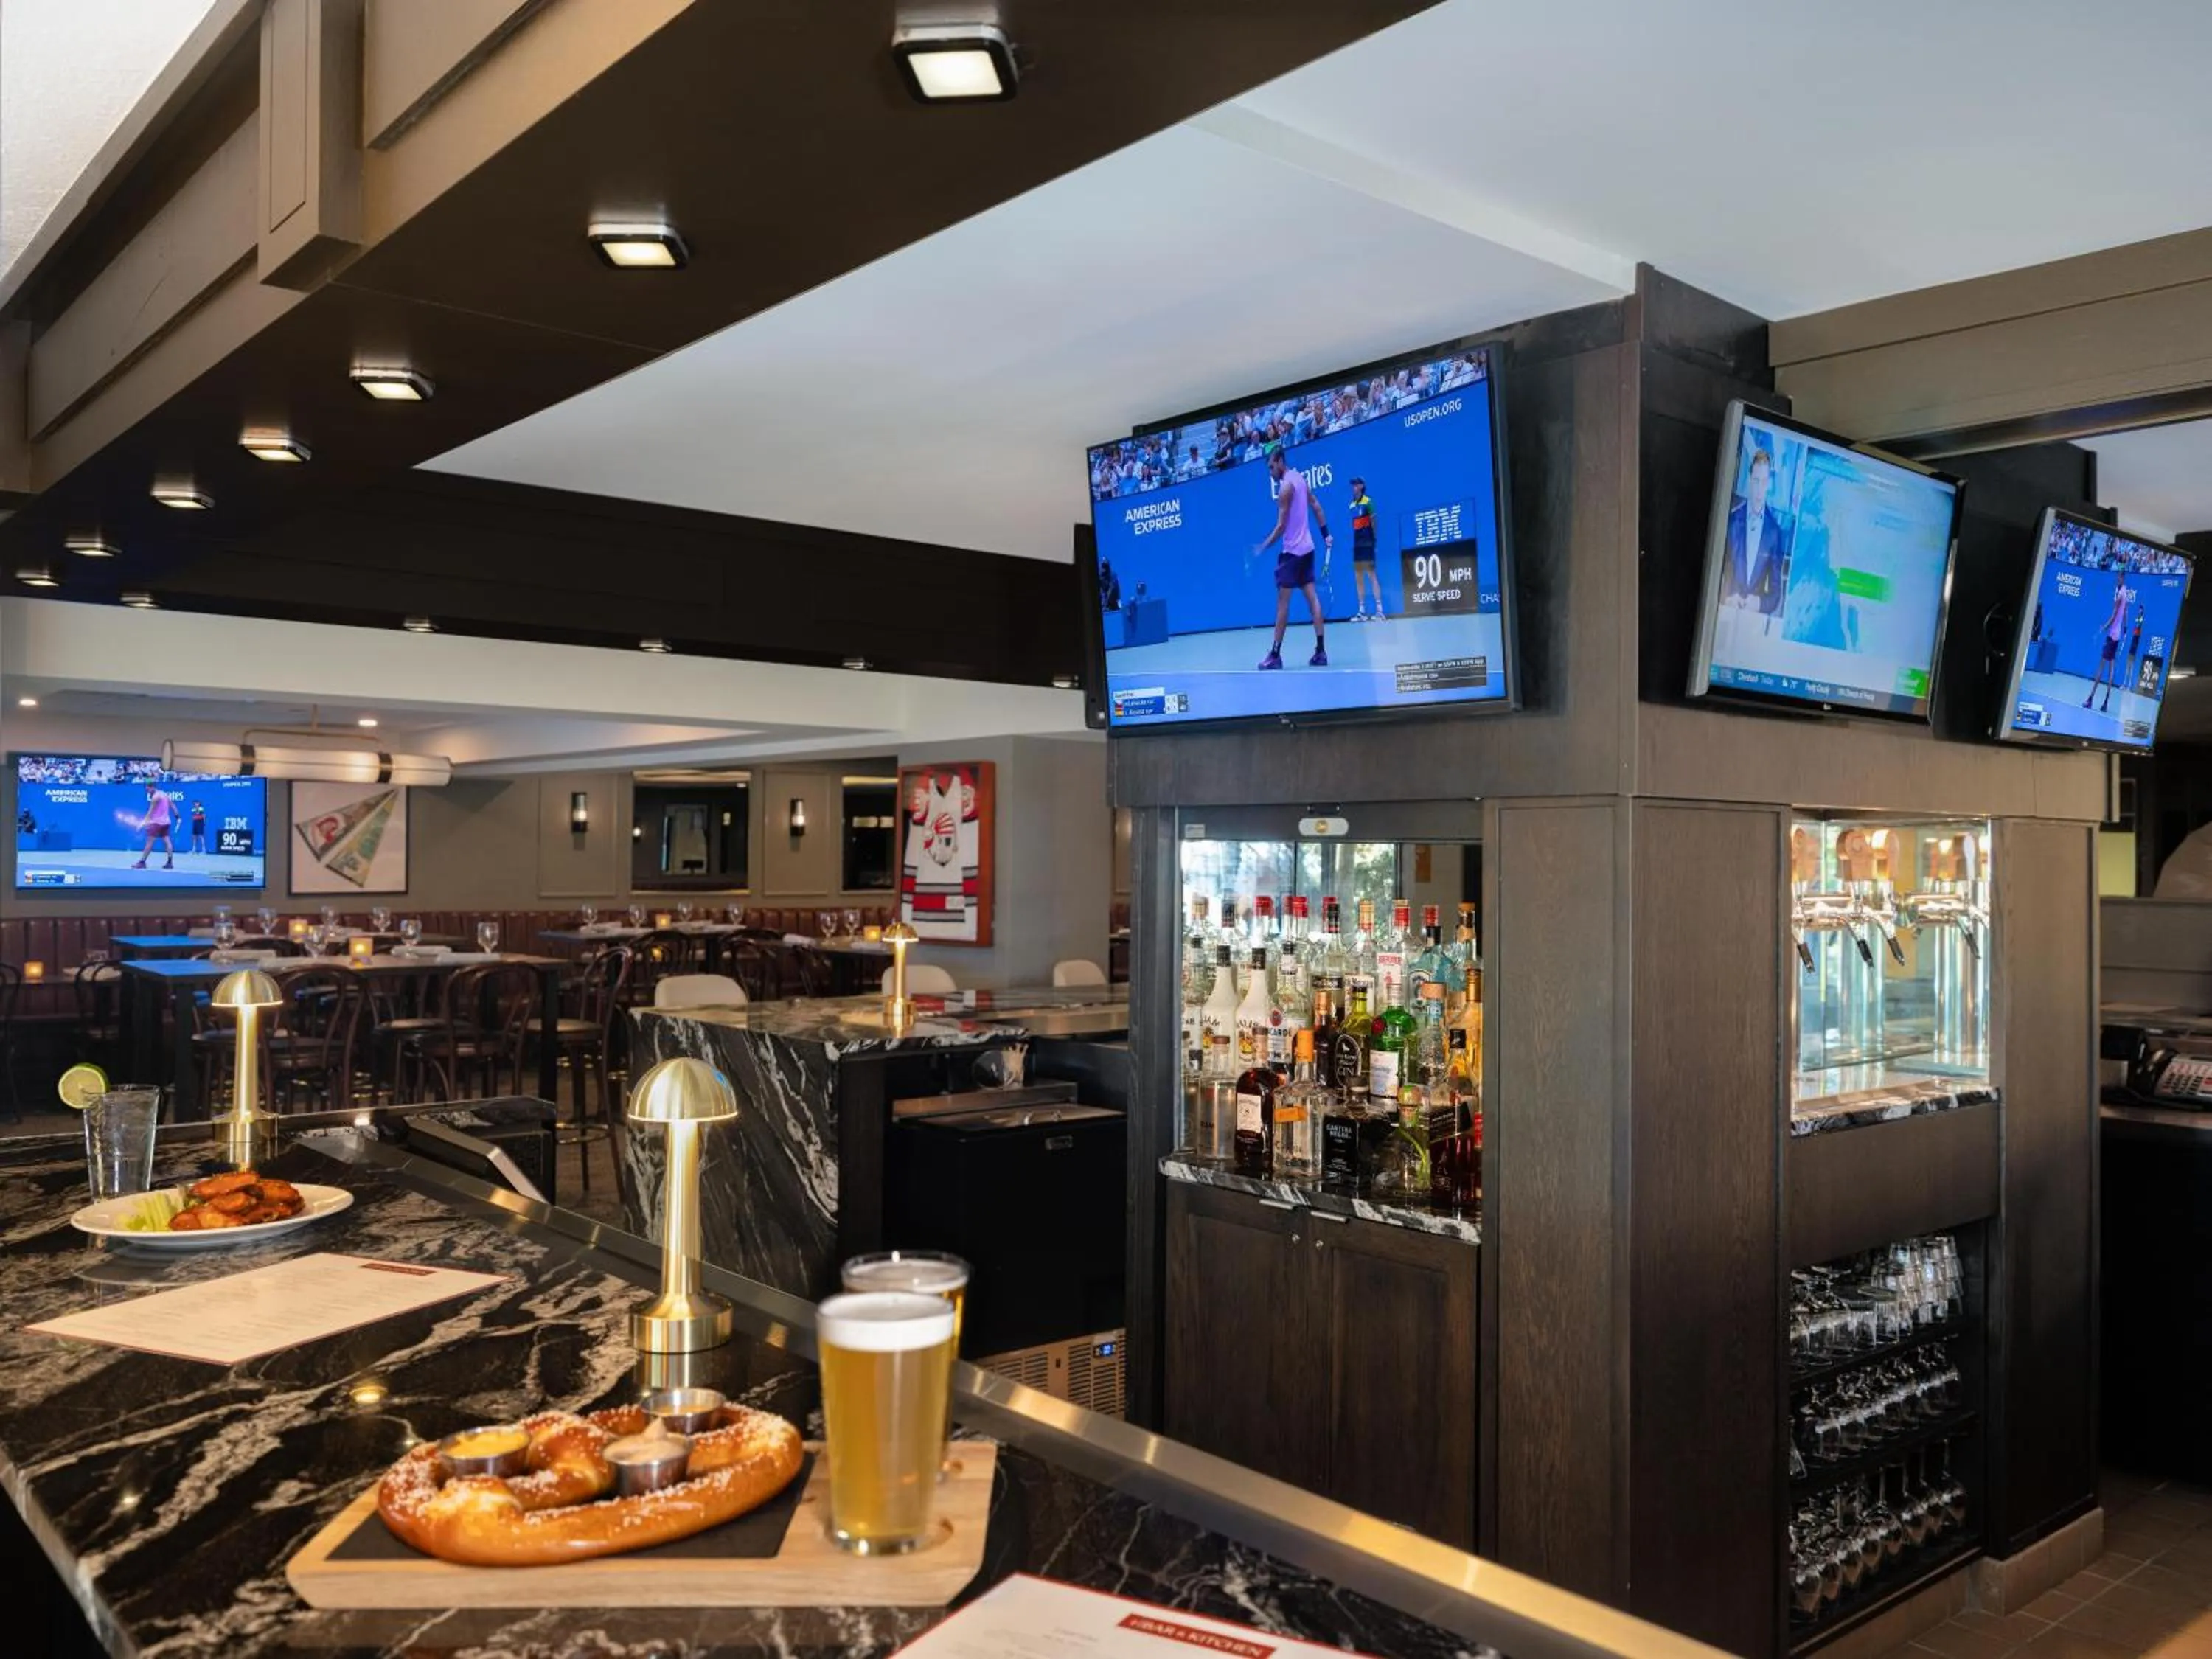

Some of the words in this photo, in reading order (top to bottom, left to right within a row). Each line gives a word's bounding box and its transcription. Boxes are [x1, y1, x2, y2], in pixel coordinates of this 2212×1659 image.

[1404, 398, 1462, 428] USOPEN.ORG
[1125, 498, 1180, 522] AMERICAN
[1134, 514, 1182, 535] EXPRESS
[1415, 505, 1462, 545] IBM
[1415, 554, 1441, 589] 90
[1449, 567, 1472, 582] MPH
[1412, 591, 1436, 602] SERVE
[1437, 589, 1461, 600] SPEED
[224, 816, 248, 830] IBM
[222, 832, 237, 846] 90
